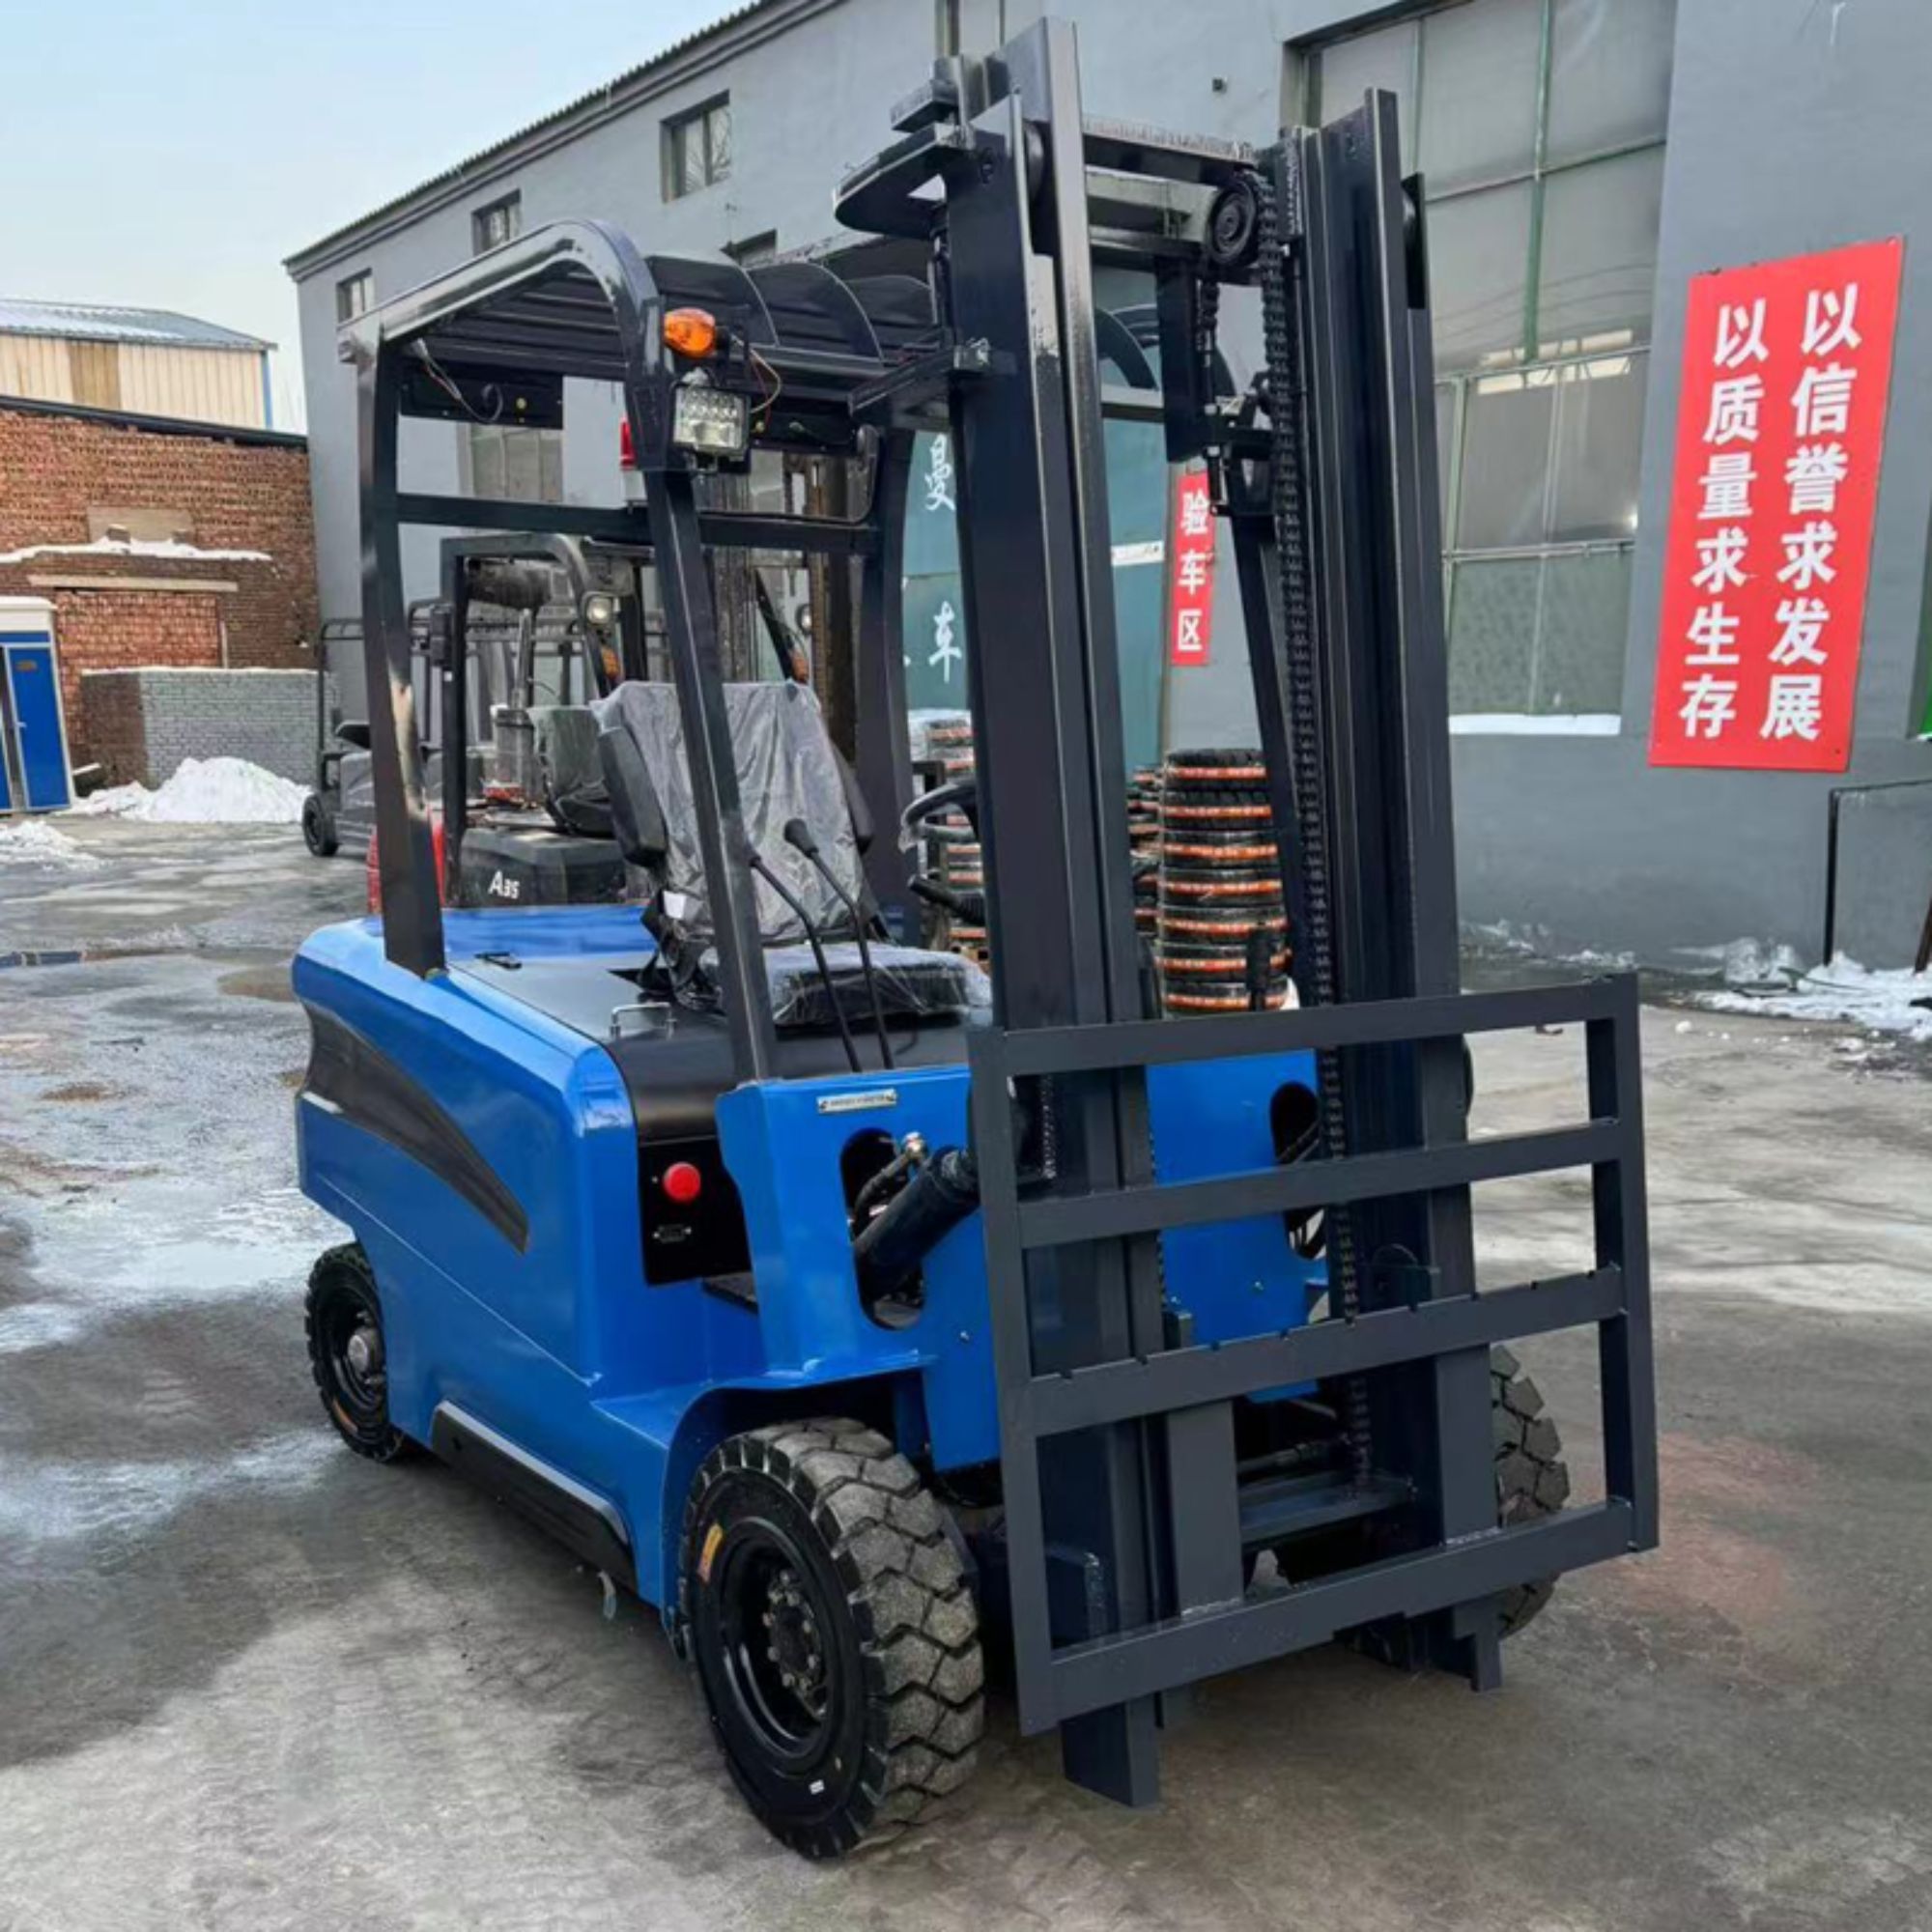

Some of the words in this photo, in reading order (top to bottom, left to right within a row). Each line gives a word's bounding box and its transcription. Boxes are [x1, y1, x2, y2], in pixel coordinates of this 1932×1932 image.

[1179, 491, 1209, 651] 验车区
[1679, 298, 1769, 738] 以质量求生存
[1761, 283, 1862, 741] 以信誉求发展
